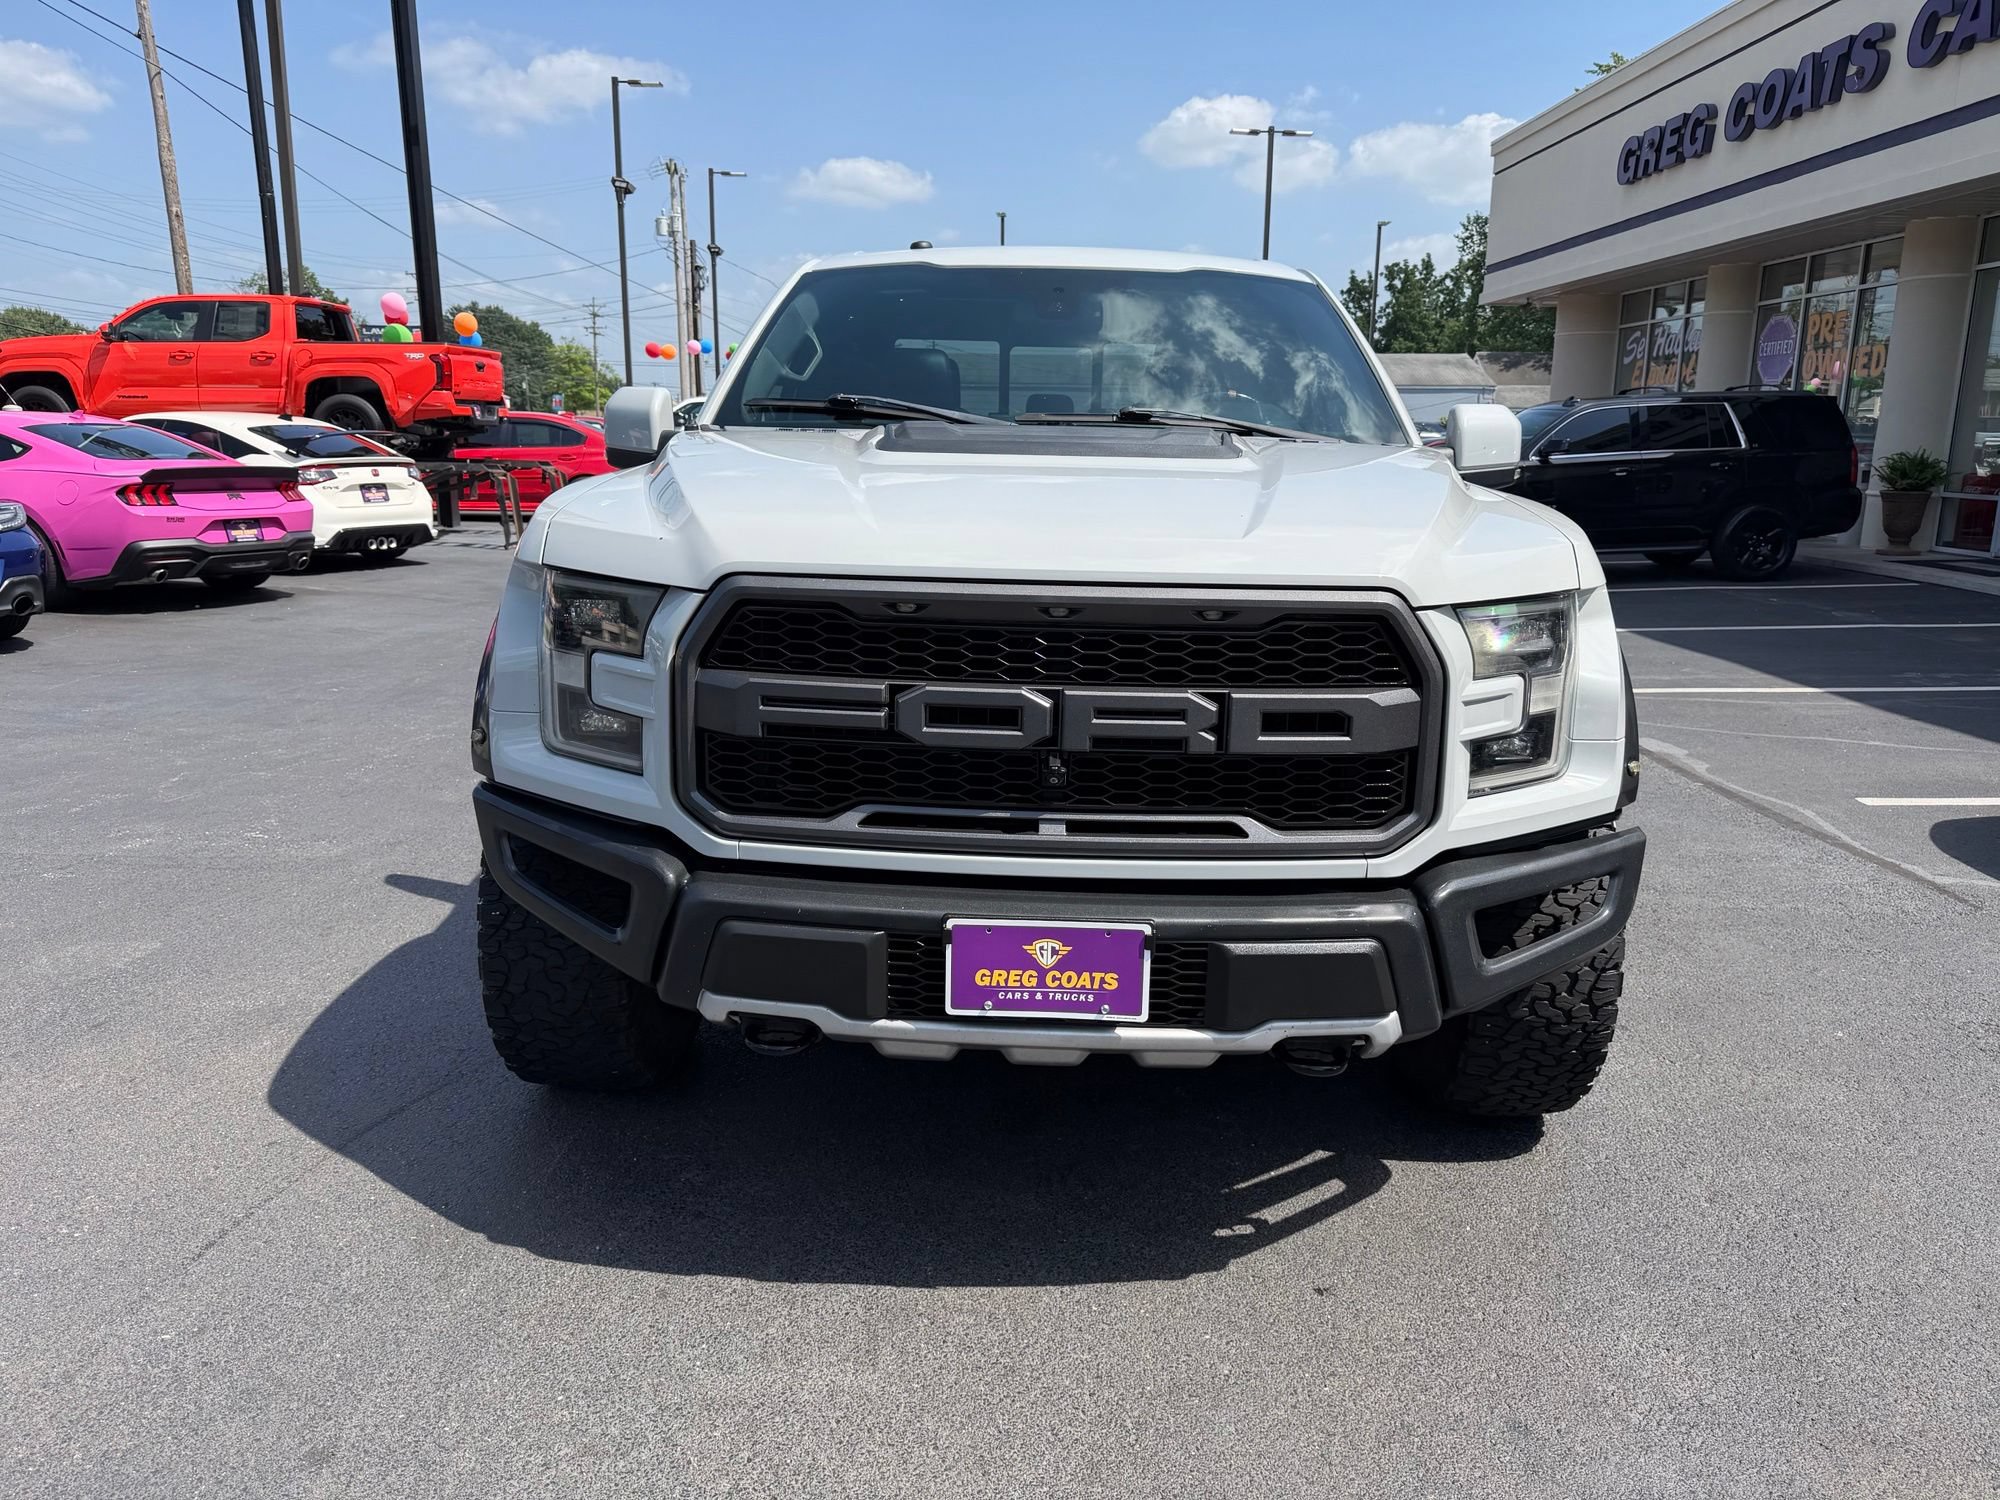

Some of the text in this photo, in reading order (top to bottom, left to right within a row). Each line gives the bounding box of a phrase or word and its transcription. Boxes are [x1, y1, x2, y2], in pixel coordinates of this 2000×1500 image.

[1617, 0, 2000, 185] GREG COATS CA
[1806, 310, 1849, 346] PRE
[403, 352, 425, 360] TRD
[1623, 331, 1647, 365] Se
[1759, 338, 1794, 357] CERTIFIED
[695, 672, 1422, 755] FORD
[974, 968, 1120, 991] GREG COATS
[998, 991, 1095, 1002] CARS & TRUCKS
